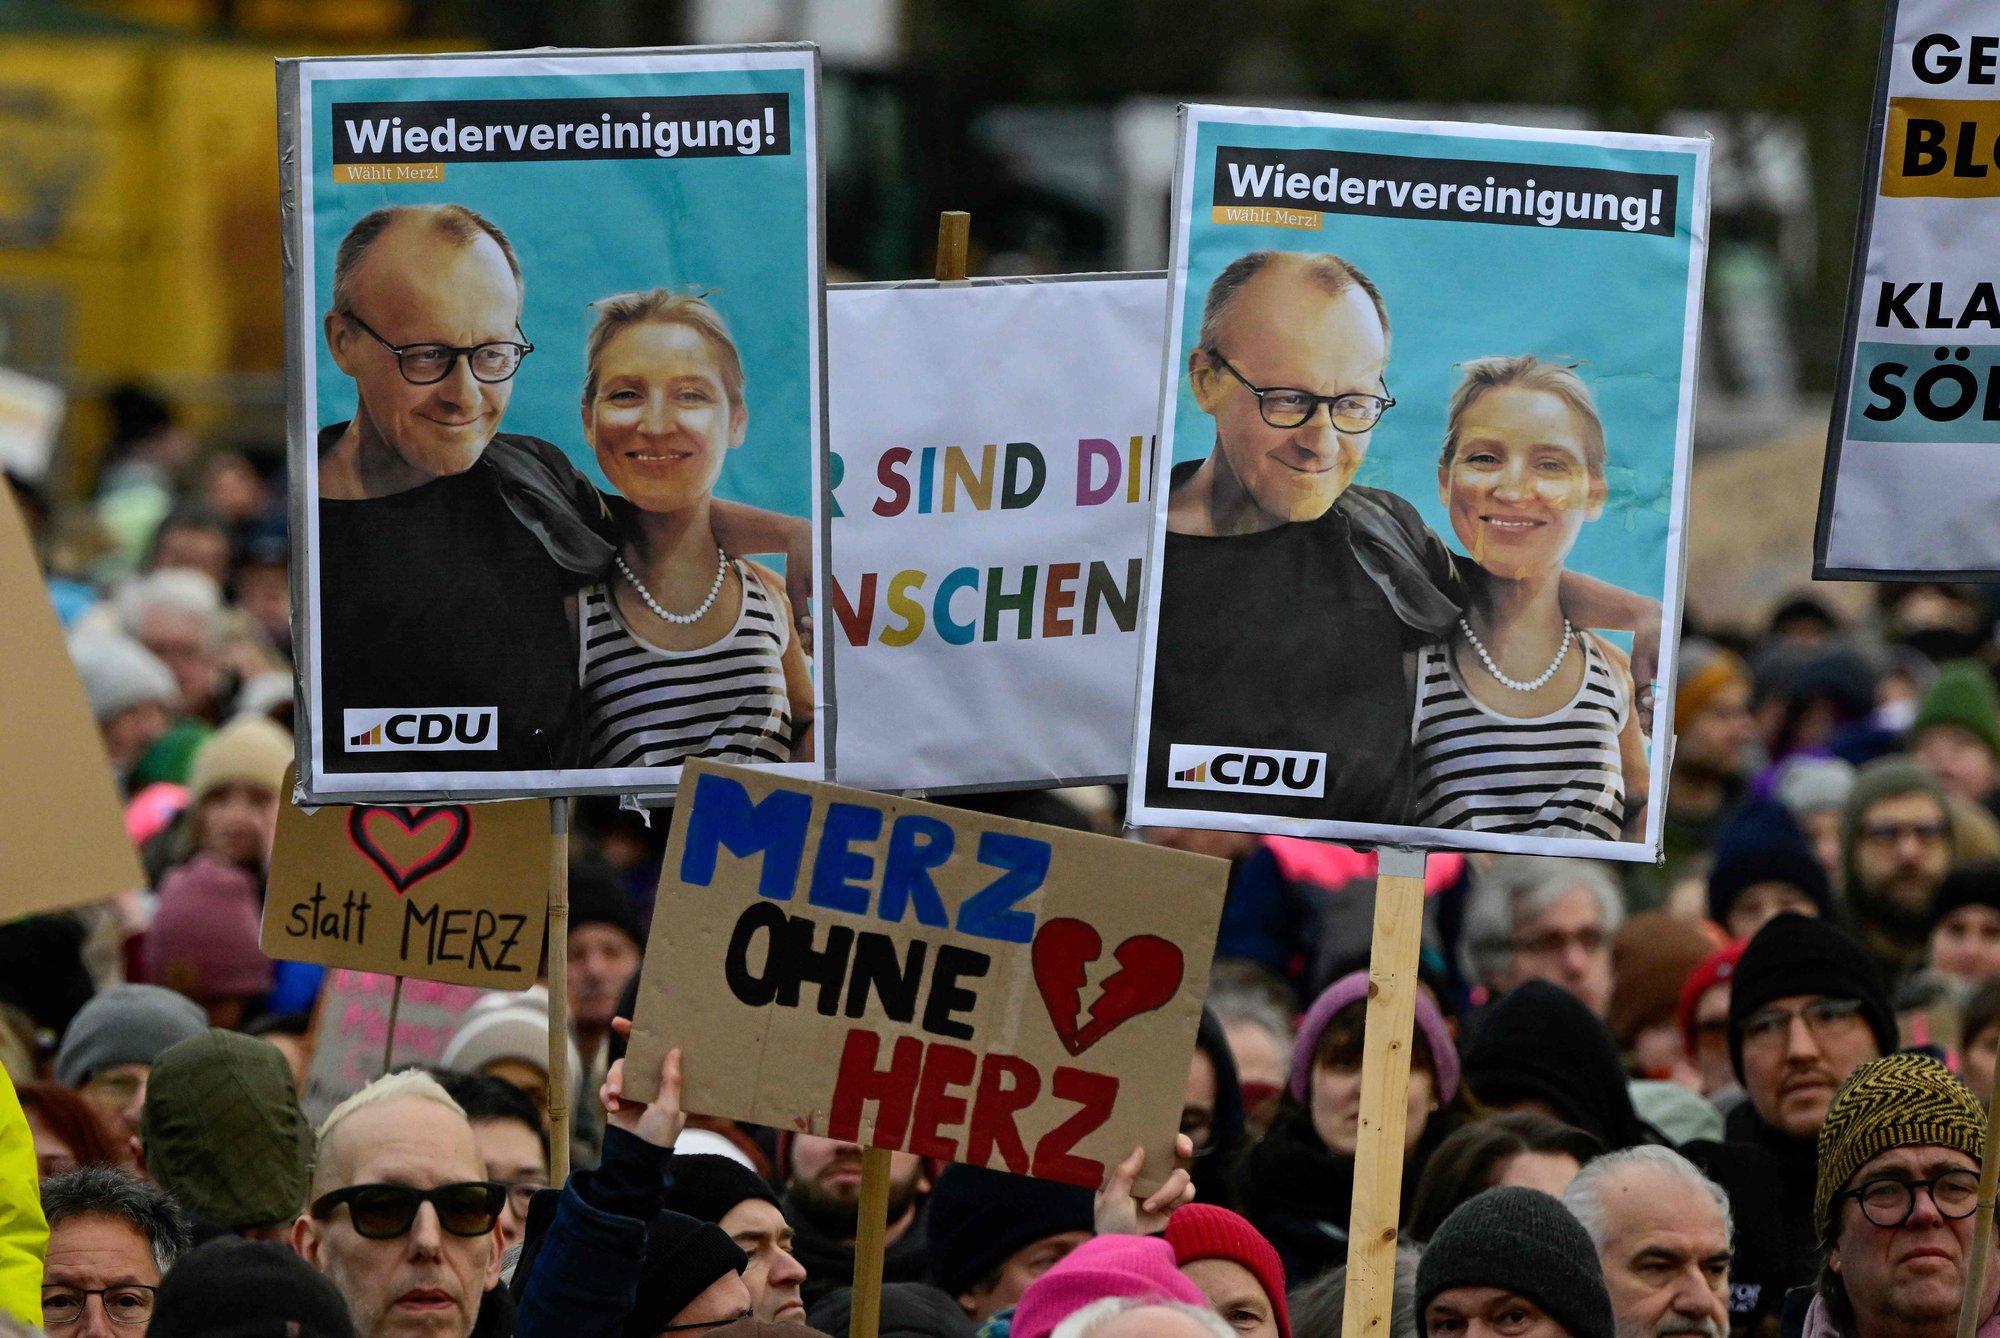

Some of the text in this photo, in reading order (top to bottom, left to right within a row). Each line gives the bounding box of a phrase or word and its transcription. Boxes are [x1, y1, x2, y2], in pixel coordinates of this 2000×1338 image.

[1912, 33, 1999, 85] GE
[344, 107, 776, 157] Wiedervereinigung!
[1902, 118, 2000, 177] BL
[347, 165, 439, 180] Wählt Merz!
[1228, 162, 1663, 232] Wiedervereinigung!
[1226, 208, 1317, 227] Wählt Merz!
[872, 442, 1047, 518] SIND
[1076, 435, 1156, 506] DI
[832, 558, 1143, 648] NSCHEN
[385, 713, 492, 744] CDU
[1210, 753, 1320, 790] CDU
[680, 773, 1052, 943] MERZ
[285, 882, 527, 972] statt MERZ
[725, 901, 991, 1040] OHNE
[827, 1028, 1120, 1190] HERZ
